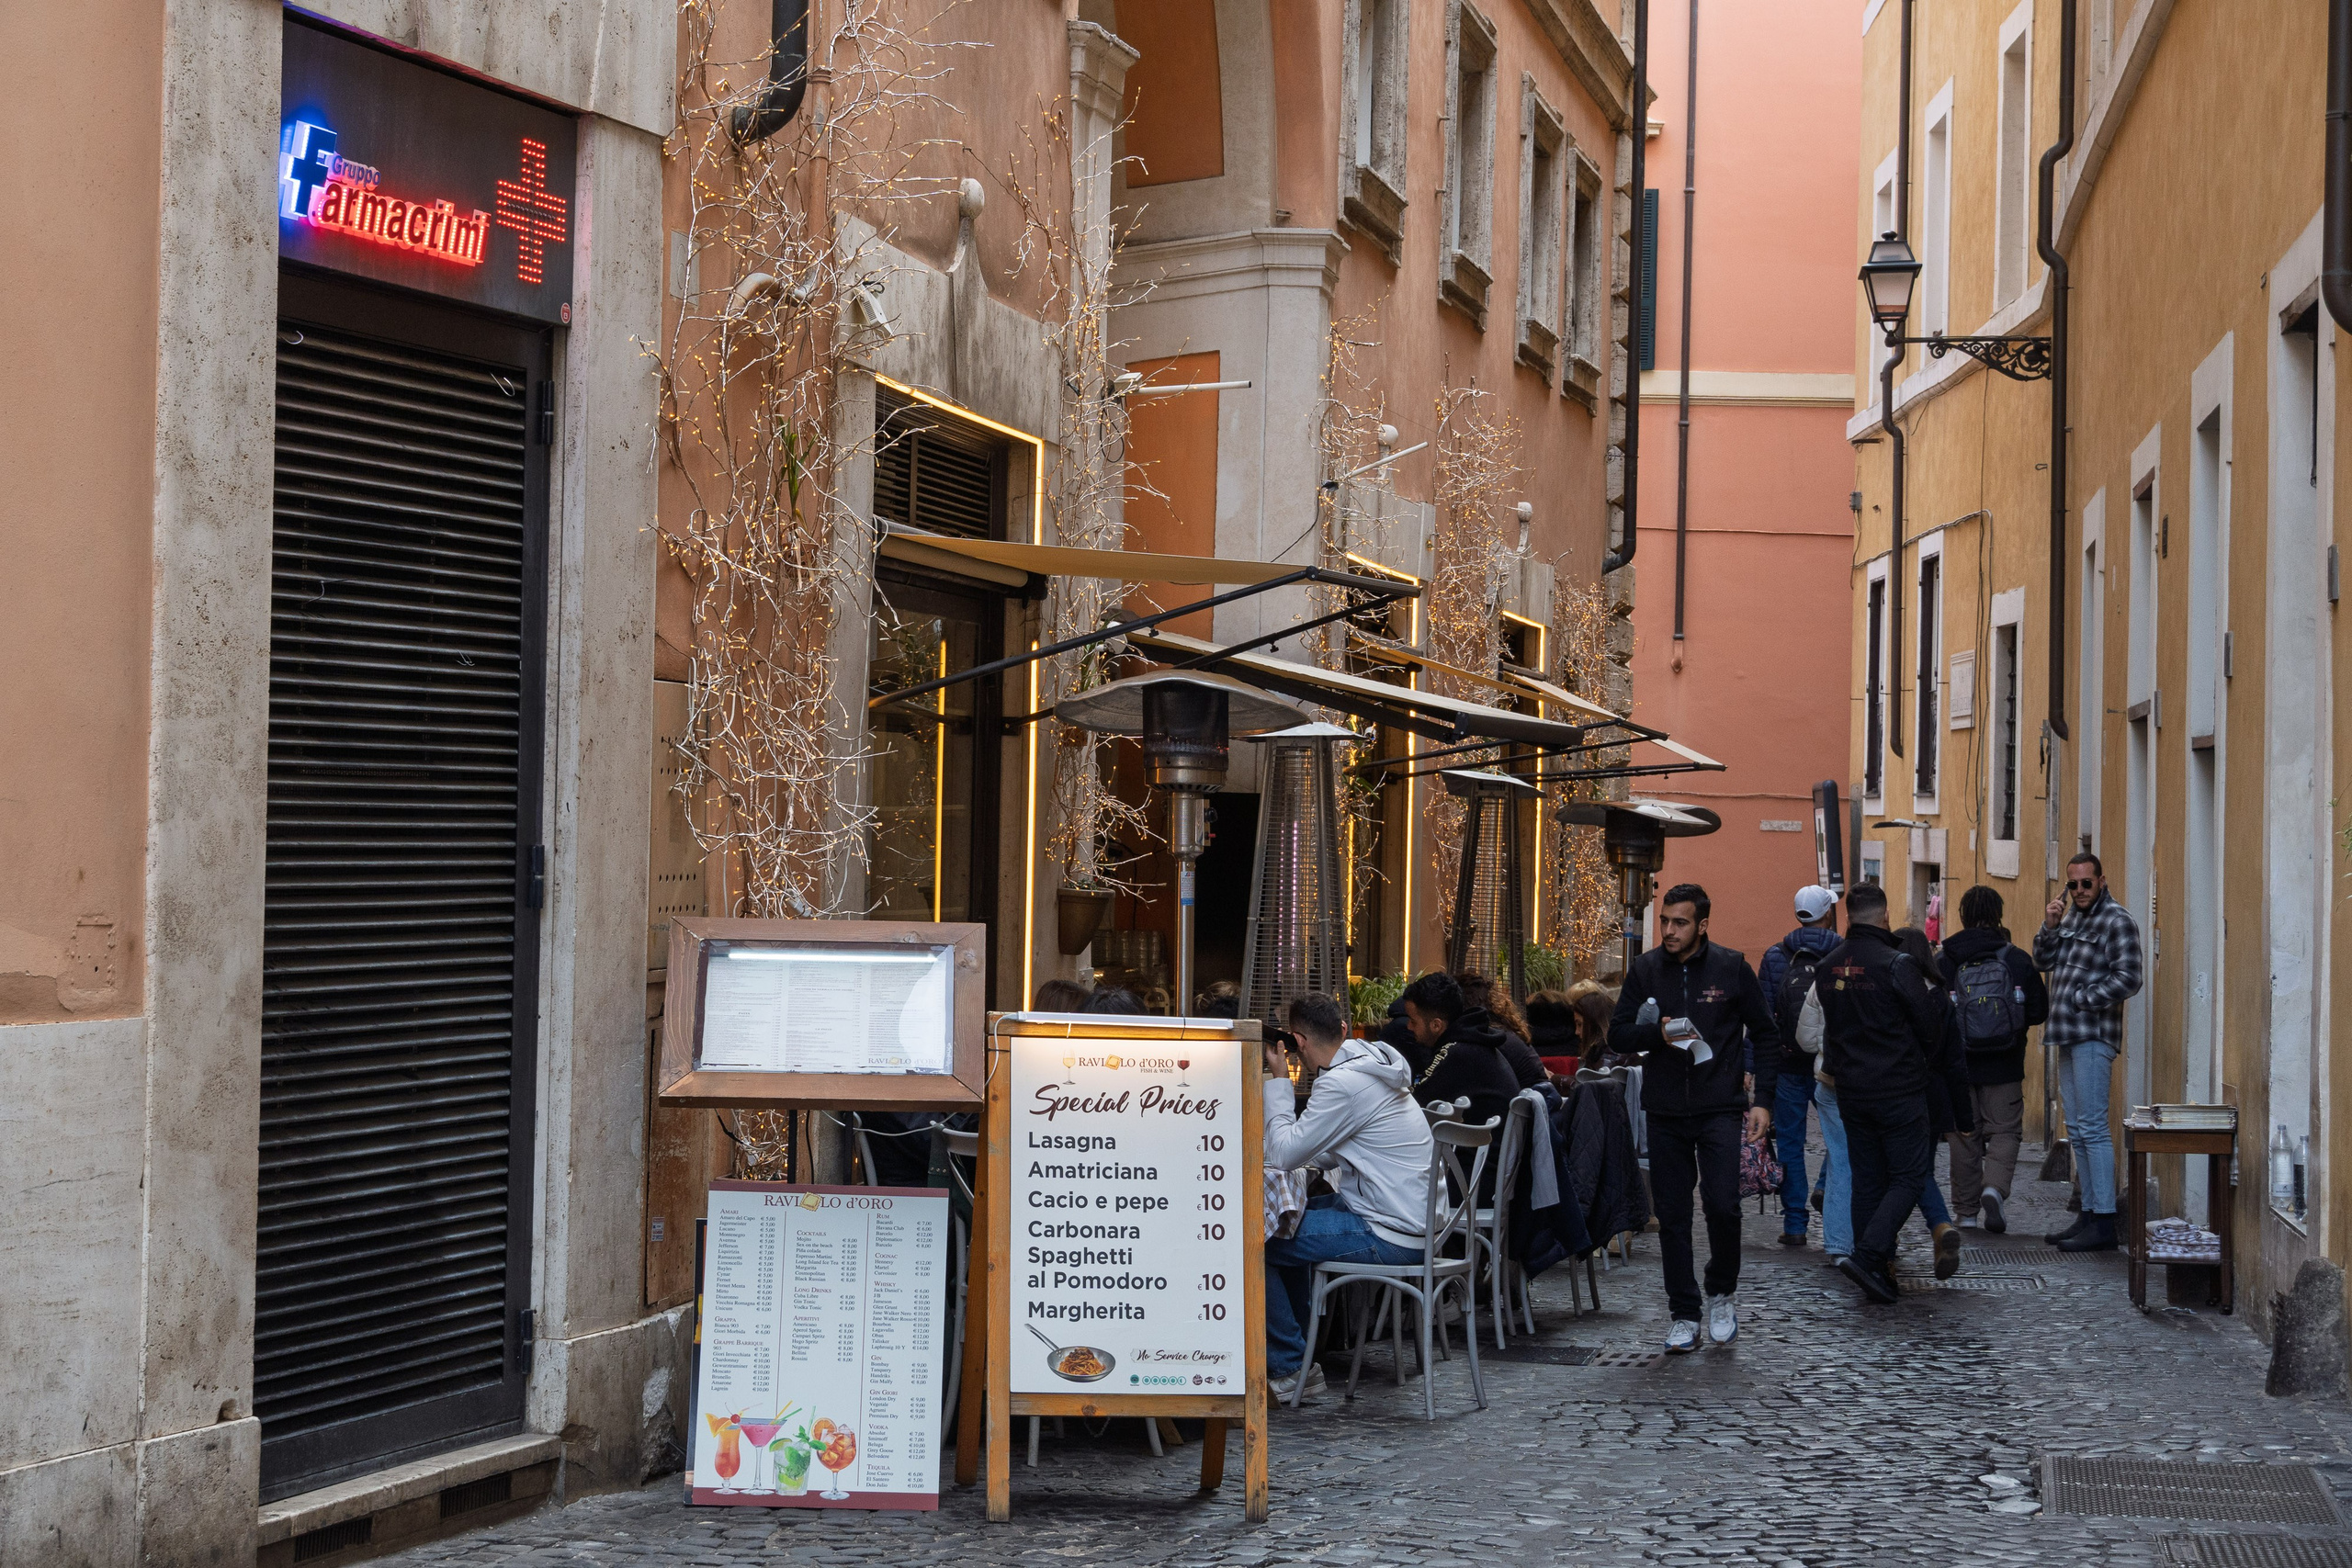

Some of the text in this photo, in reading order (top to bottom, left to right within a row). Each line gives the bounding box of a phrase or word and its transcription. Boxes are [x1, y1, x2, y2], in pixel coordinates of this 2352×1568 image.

[332, 154, 381, 186] Gruppo
[868, 1056, 911, 1066] RAVILO
[1079, 1055, 1174, 1070] RAVILO d'ORO
[1029, 1084, 1222, 1121] Special Prices
[1029, 1131, 1116, 1152] Lasagna
[1028, 1161, 1157, 1180] Amatriciana
[764, 1193, 893, 1212] RAVILO d'ORO
[1028, 1191, 1088, 1209] Cacio
[1096, 1196, 1107, 1209] e
[1116, 1196, 1169, 1213] pepe
[1028, 1221, 1140, 1239] Carbonara
[1028, 1246, 1132, 1267] Spaghetti
[1028, 1271, 1045, 1288] al
[1055, 1272, 1167, 1290] Pomodoro
[1028, 1302, 1144, 1322] Margherita
[1137, 1349, 1226, 1364] No Service Charge
